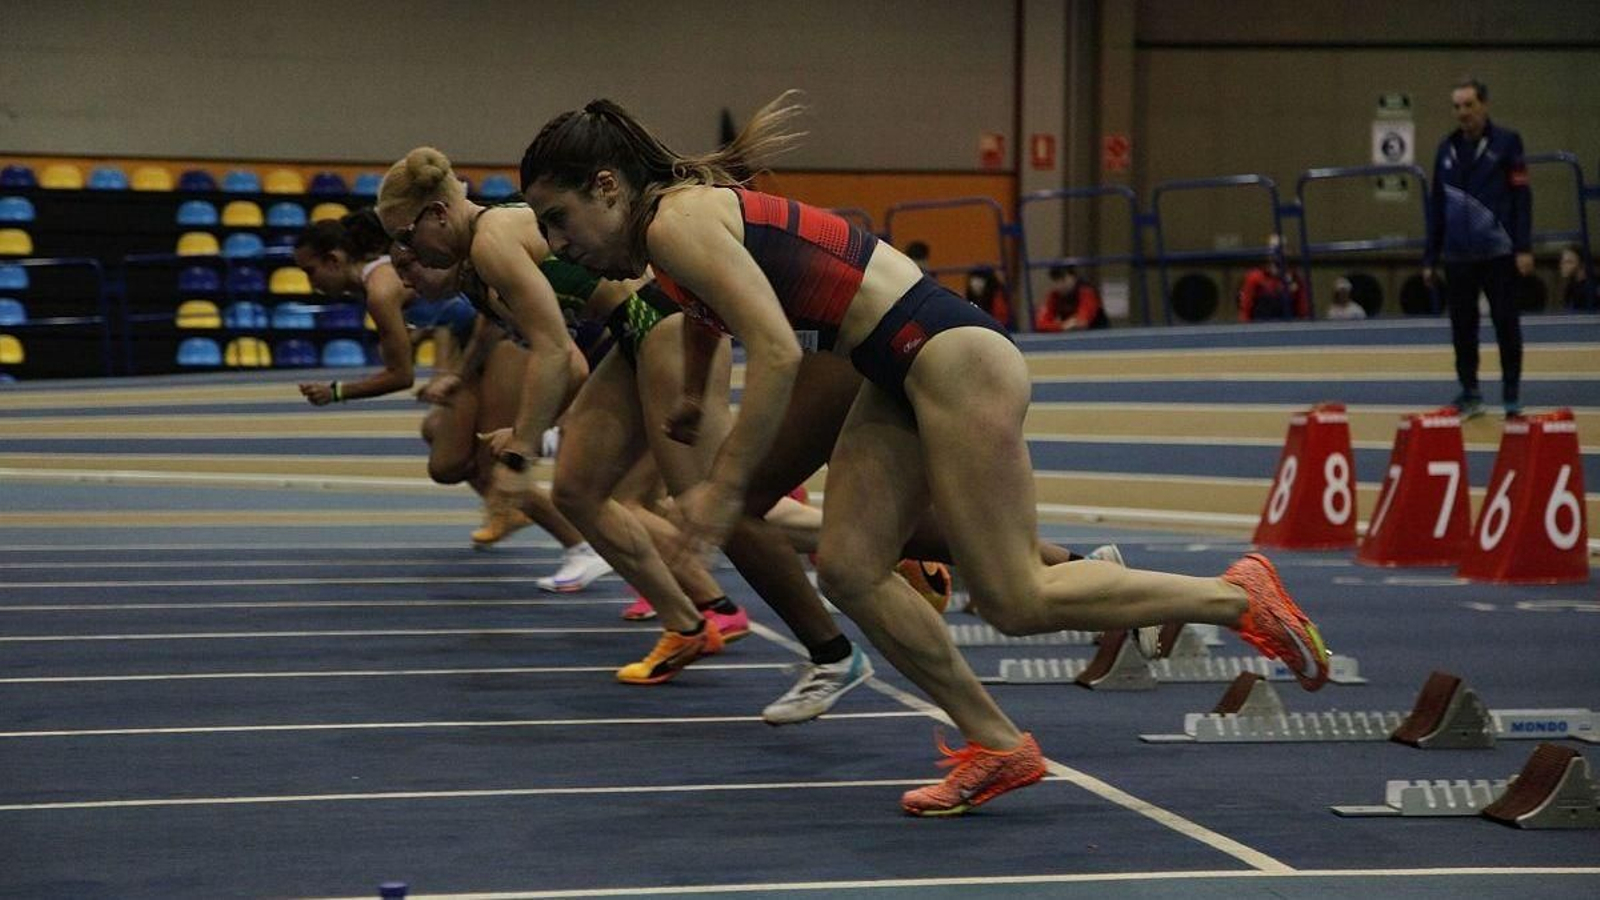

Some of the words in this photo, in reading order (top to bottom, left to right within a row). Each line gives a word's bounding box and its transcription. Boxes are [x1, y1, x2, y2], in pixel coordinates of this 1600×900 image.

[1268, 455, 1298, 525] 8
[1323, 453, 1351, 525] 8
[1370, 464, 1402, 536] 7
[1428, 461, 1460, 538] 7
[1480, 470, 1515, 551] 6
[1545, 464, 1581, 550] 6
[1511, 720, 1568, 733] MONDO
